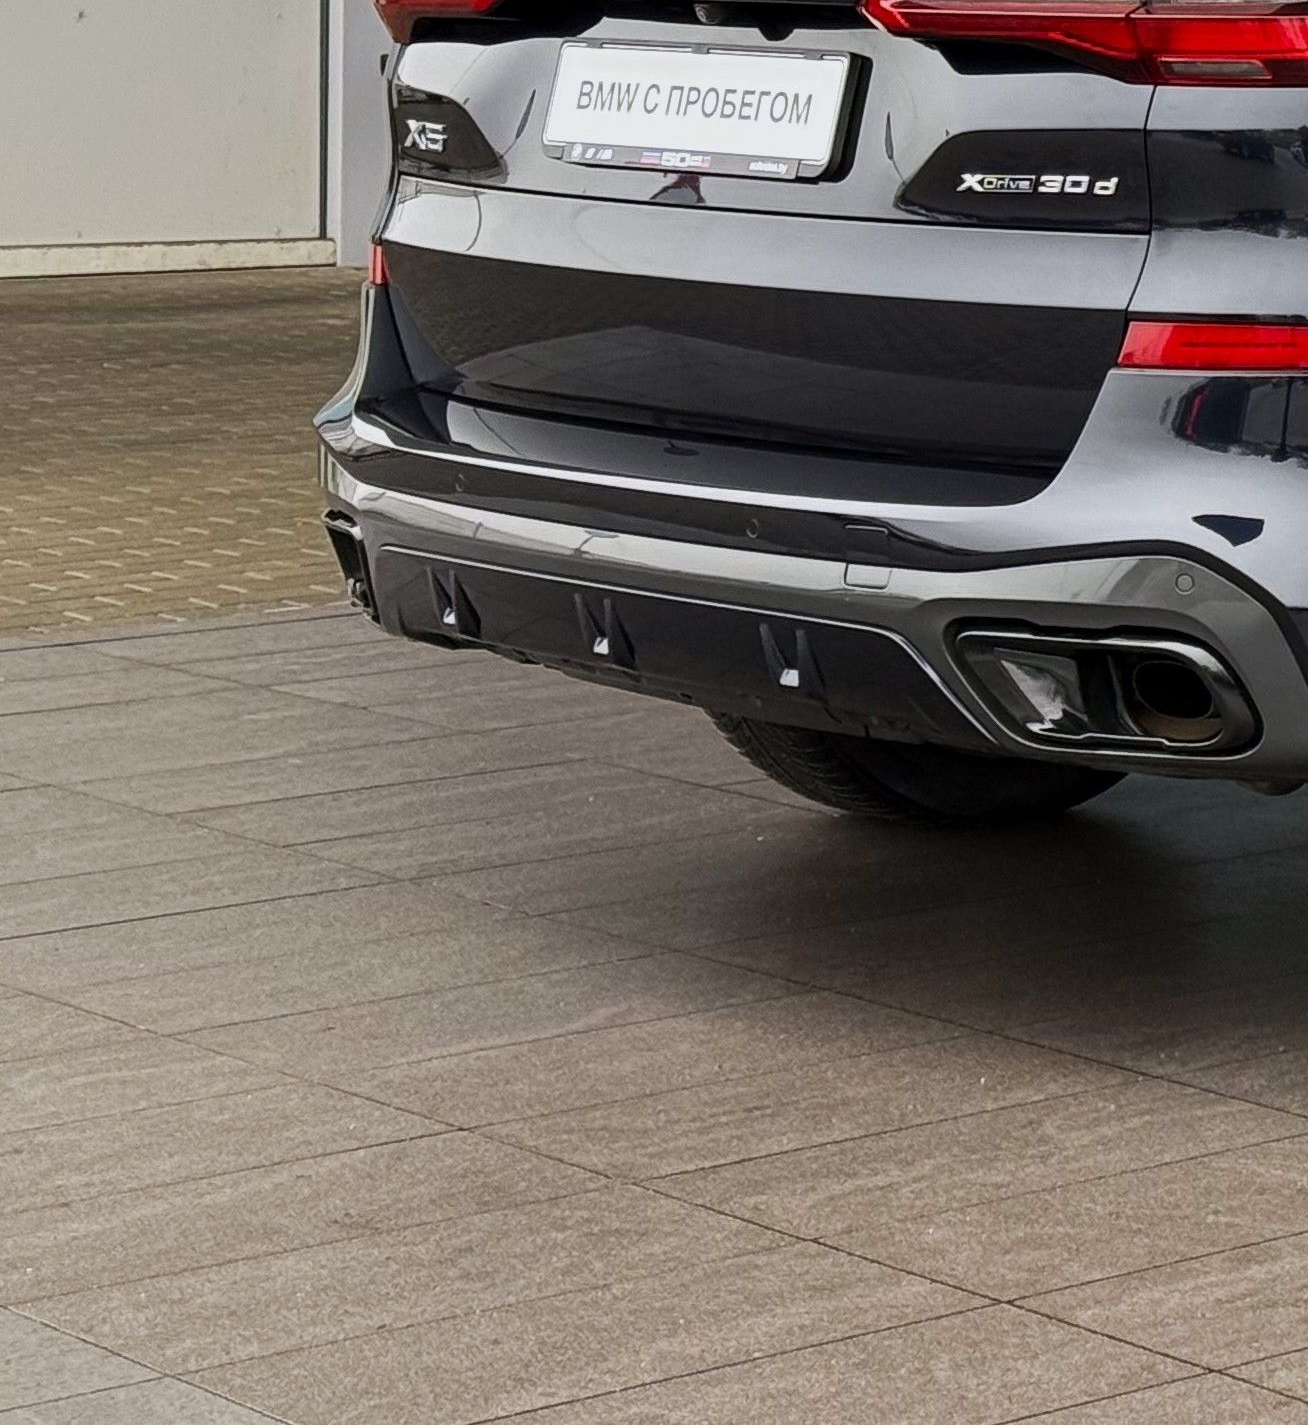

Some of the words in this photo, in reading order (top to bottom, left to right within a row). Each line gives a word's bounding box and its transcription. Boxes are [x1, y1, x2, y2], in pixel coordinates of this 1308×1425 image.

[576, 79, 641, 113] BMW
[664, 84, 813, 126] ПРОБЕГОМ
[404, 118, 448, 153] X5
